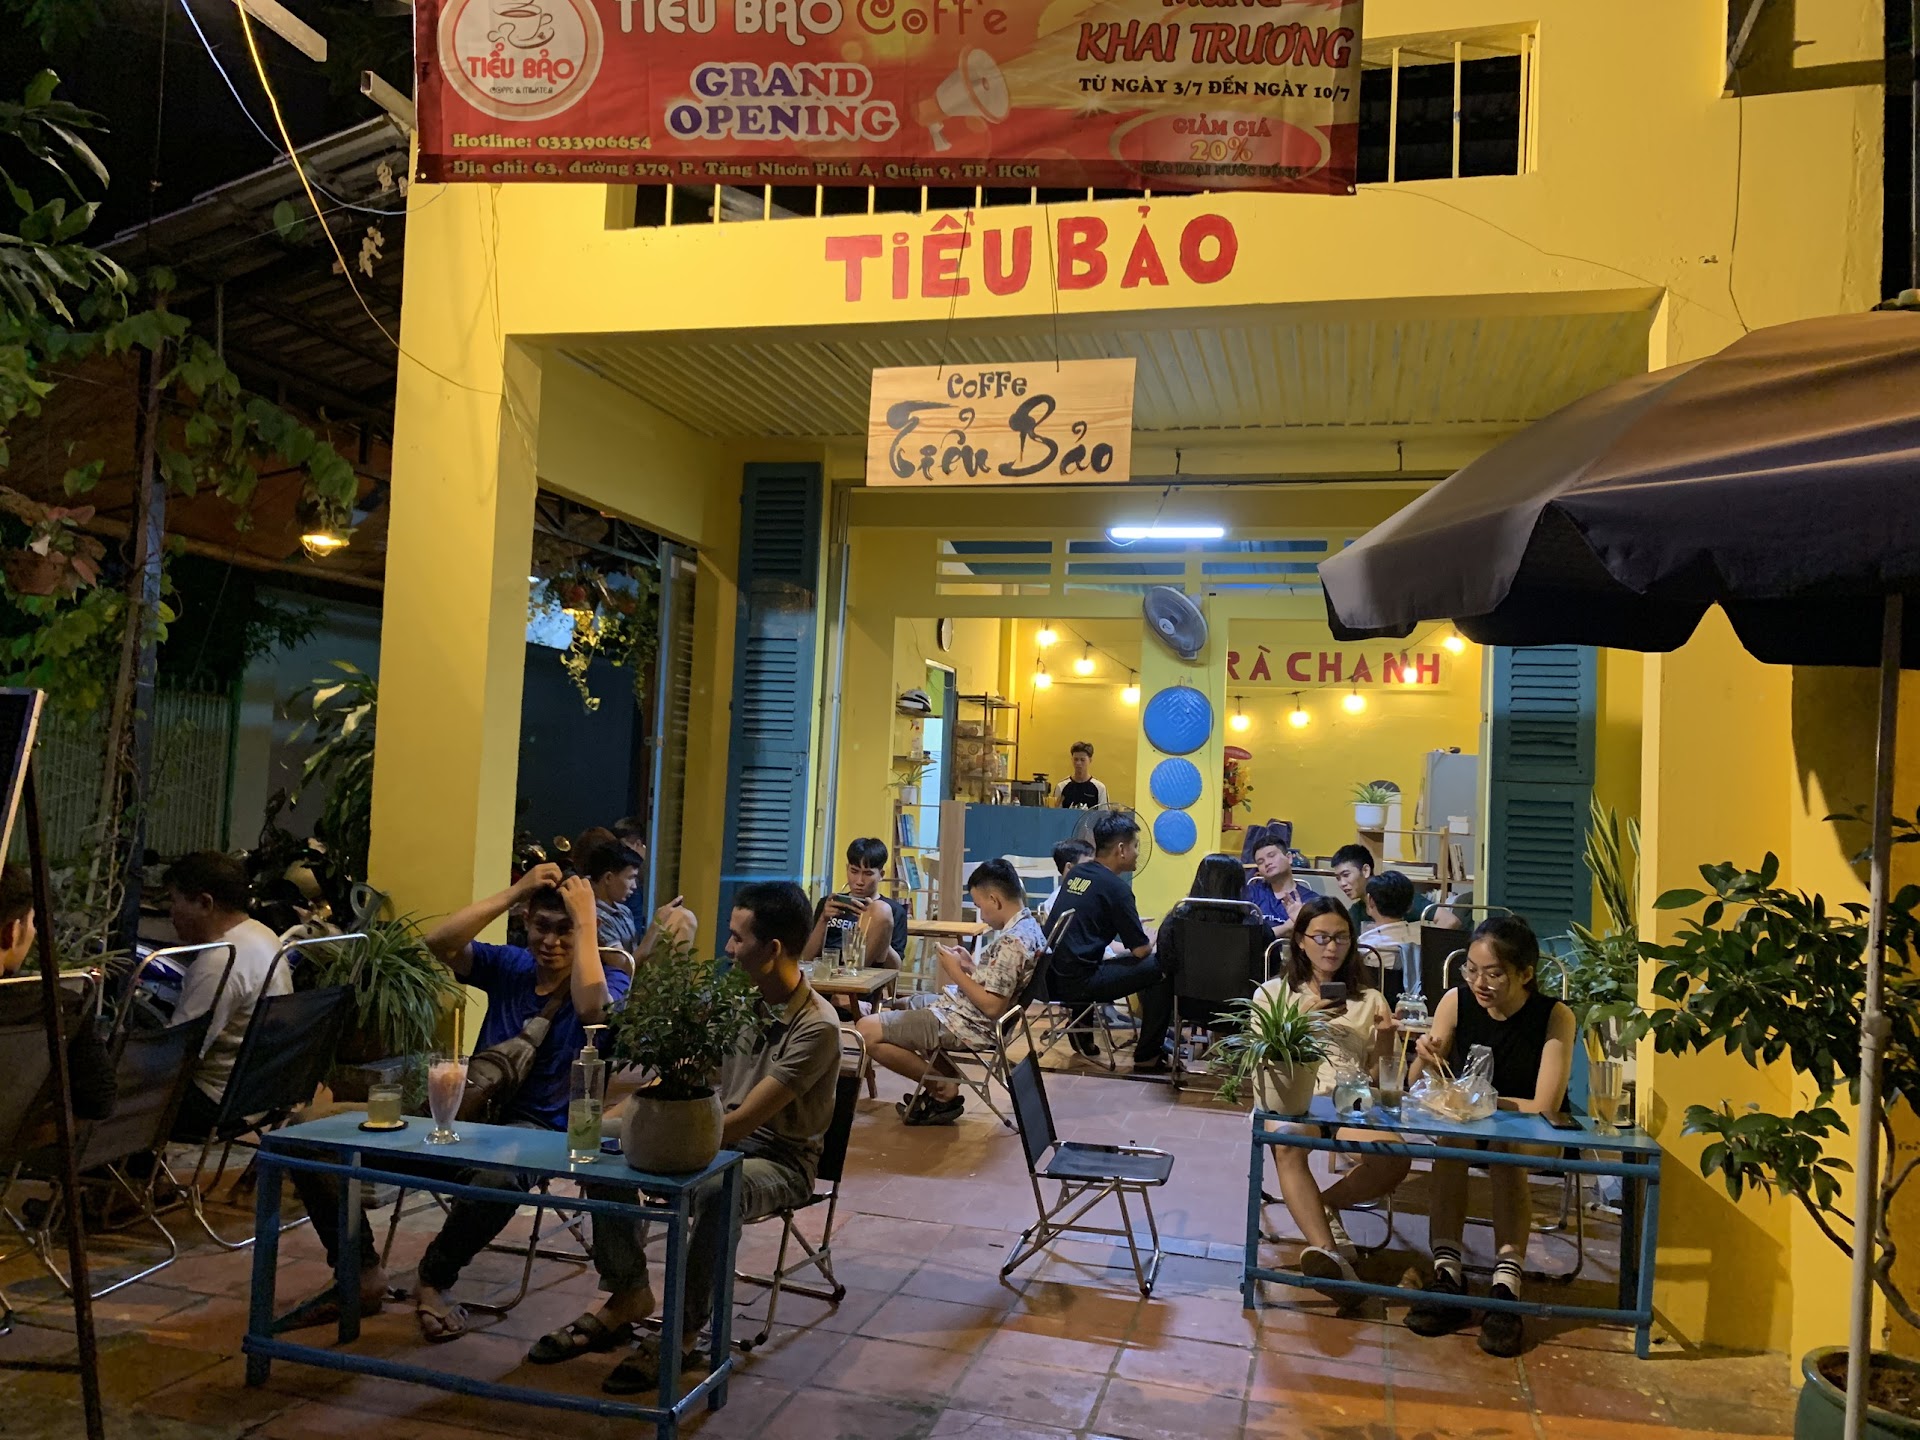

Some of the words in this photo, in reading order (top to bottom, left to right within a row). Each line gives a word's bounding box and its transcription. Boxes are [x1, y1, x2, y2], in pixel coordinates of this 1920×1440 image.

[1076, 19, 1180, 64] KHAI
[1190, 21, 1354, 68] TRƯƠNG
[467, 42, 515, 80] TIỂU
[523, 48, 576, 86] BẢO
[695, 65, 868, 99] GRAND
[1079, 74, 1106, 92] TỪ
[1112, 76, 1168, 94] NGÀY
[1173, 80, 1203, 97] 3/7
[1208, 75, 1247, 95] ĐẾN
[1254, 79, 1308, 98] NGÀY
[1314, 85, 1351, 102] 10/7
[669, 103, 896, 137] OPENING
[1172, 112, 1230, 136] GIẢM
[1233, 115, 1272, 138] GIÁ
[453, 133, 532, 148] Hotline:
[537, 135, 653, 150] 0333906654
[1190, 136, 1254, 162] 20%
[453, 160, 486, 177] Địa
[493, 159, 528, 174] chỉ:
[534, 162, 563, 176] 63,
[569, 161, 629, 177] đường
[635, 162, 674, 177] 379,
[680, 162, 699, 176] P.
[705, 162, 752, 178] Tăng
[759, 162, 809, 176] Nhơn
[816, 162, 853, 176] Phú
[859, 163, 879, 178] A,
[885, 163, 934, 180] Quận
[939, 165, 956, 179] 9,
[962, 164, 992, 178] TP.
[999, 165, 1040, 178] HCM
[1056, 205, 1239, 291] BẢO
[997, 394, 1114, 477] Bảo
[1287, 651, 1440, 684] CHANH
